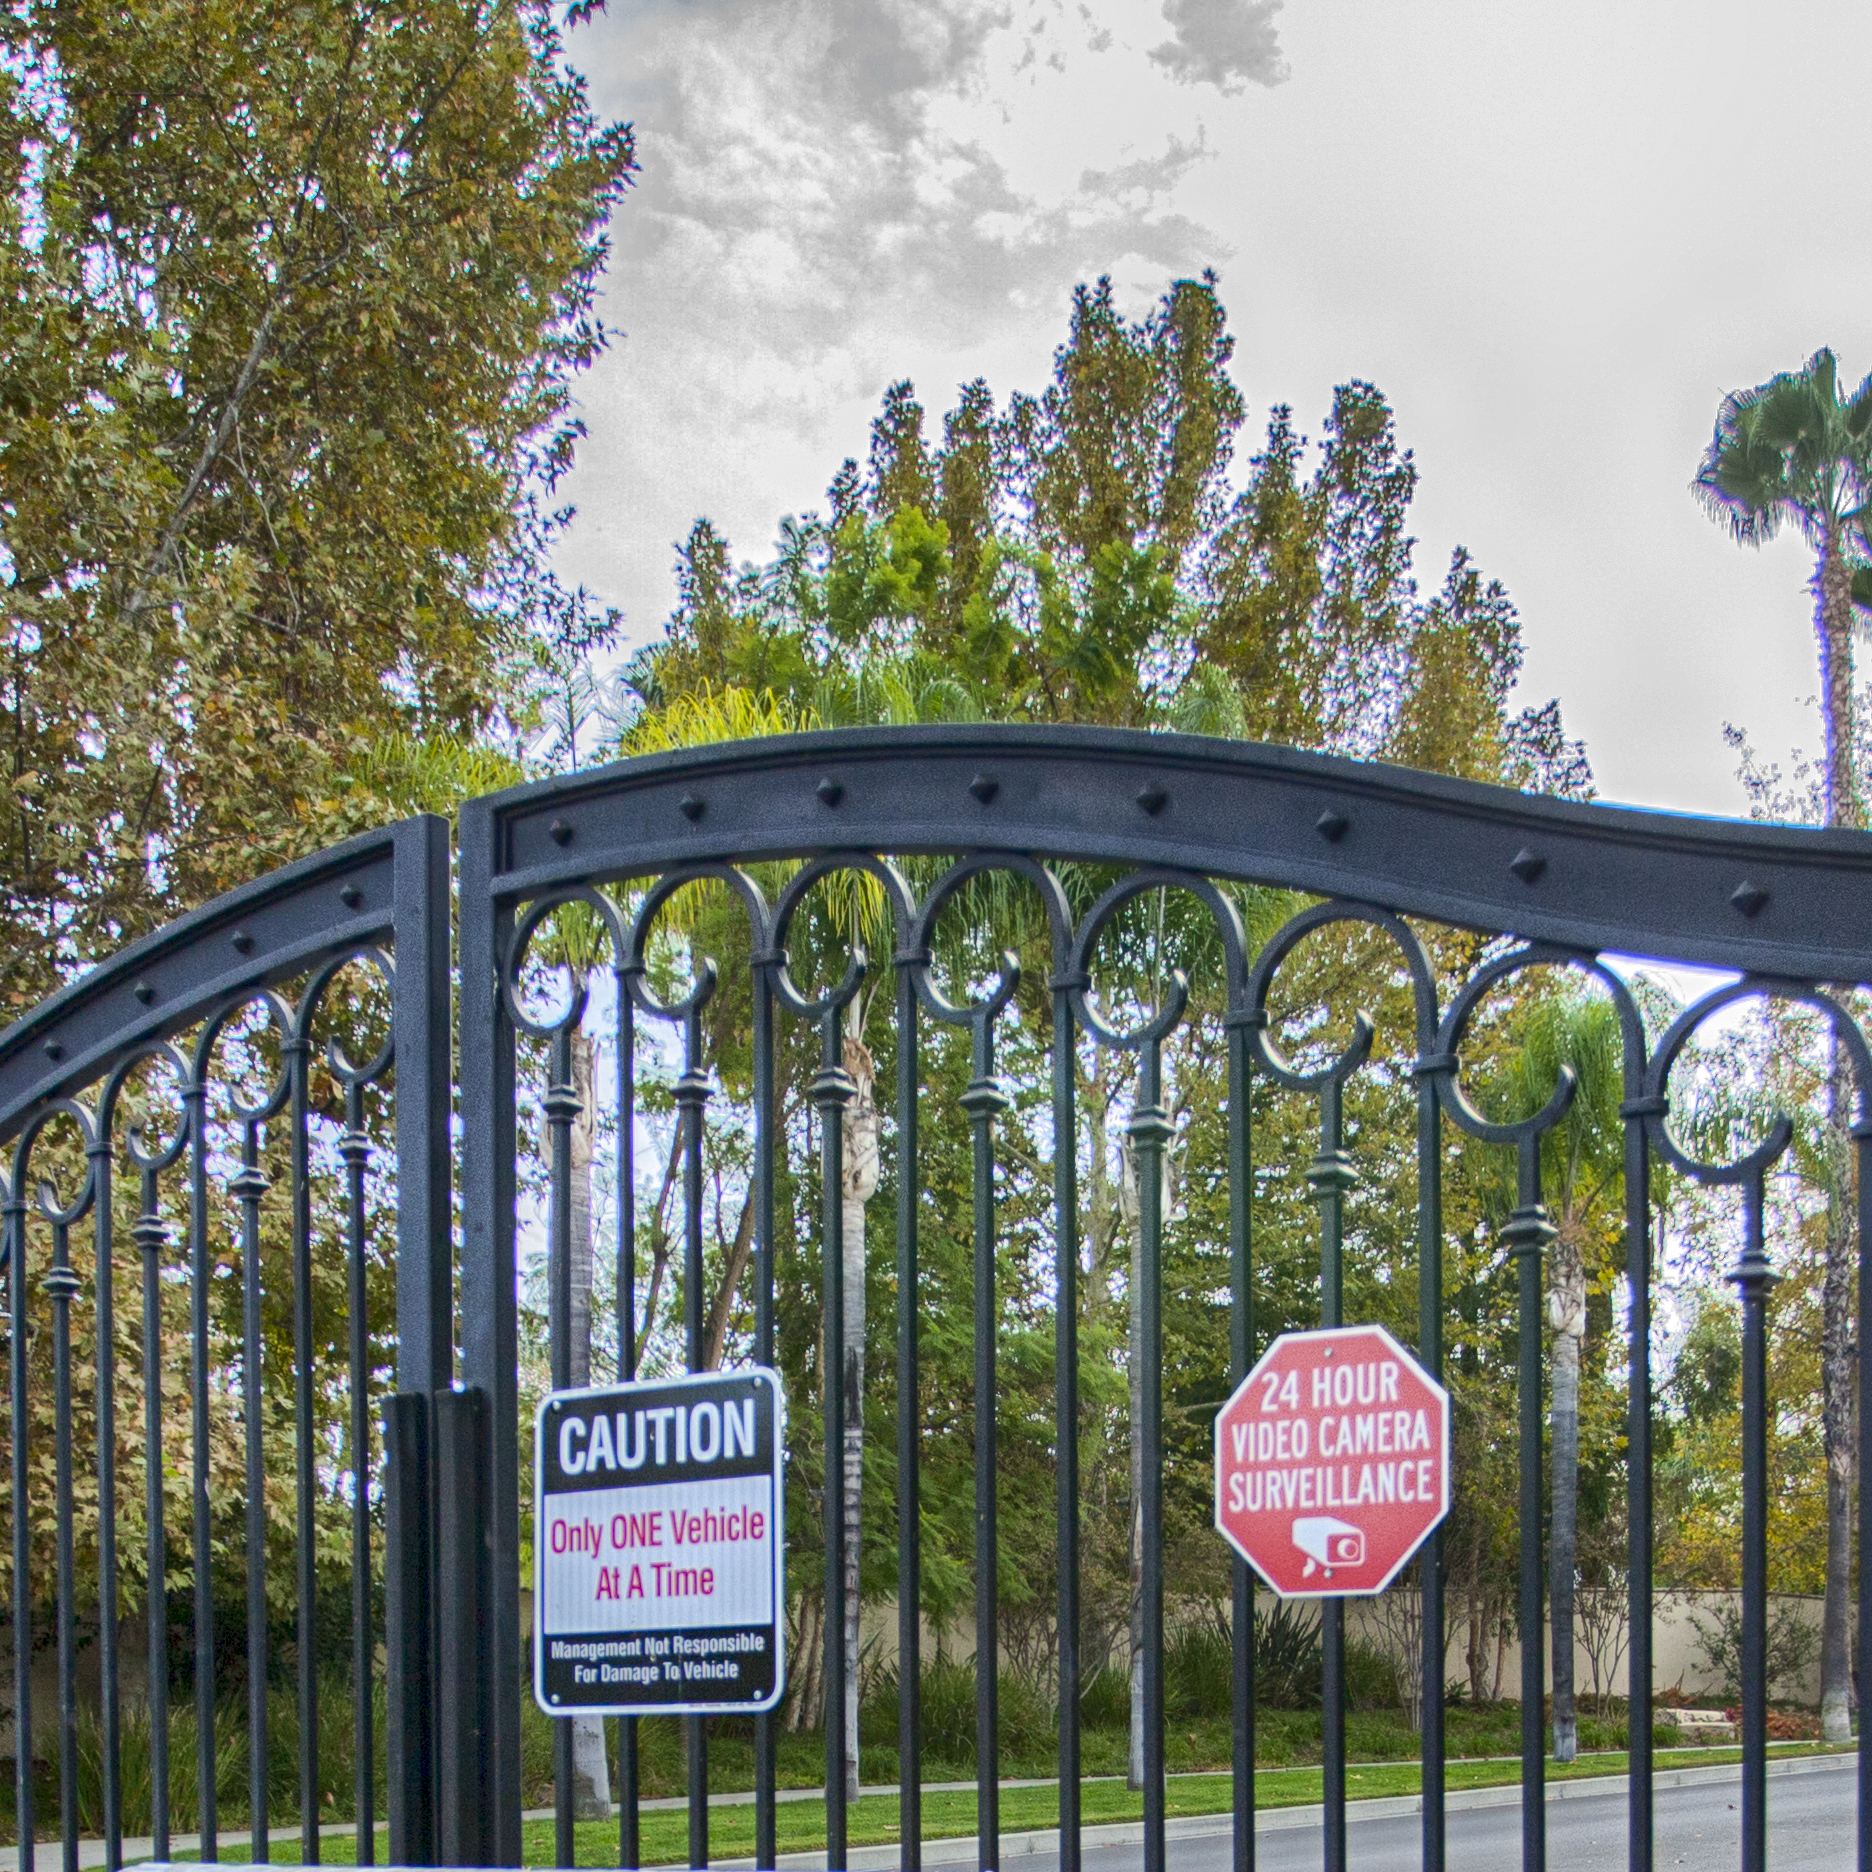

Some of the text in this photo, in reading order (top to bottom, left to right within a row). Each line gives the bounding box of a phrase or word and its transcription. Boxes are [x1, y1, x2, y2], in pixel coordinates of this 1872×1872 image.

[1260, 1361, 1399, 1412] 24 HOUR
[558, 1398, 756, 1476] CAUTION
[1231, 1408, 1430, 1463] VIDEO CAMERA
[1228, 1459, 1433, 1513] SURVEILLANCE
[551, 1504, 765, 1559] Only ONE Vehicle
[595, 1561, 714, 1600] At A Time
[551, 1632, 765, 1662] Management Not Responsible
[574, 1660, 739, 1685] For Damage To Vehicle
